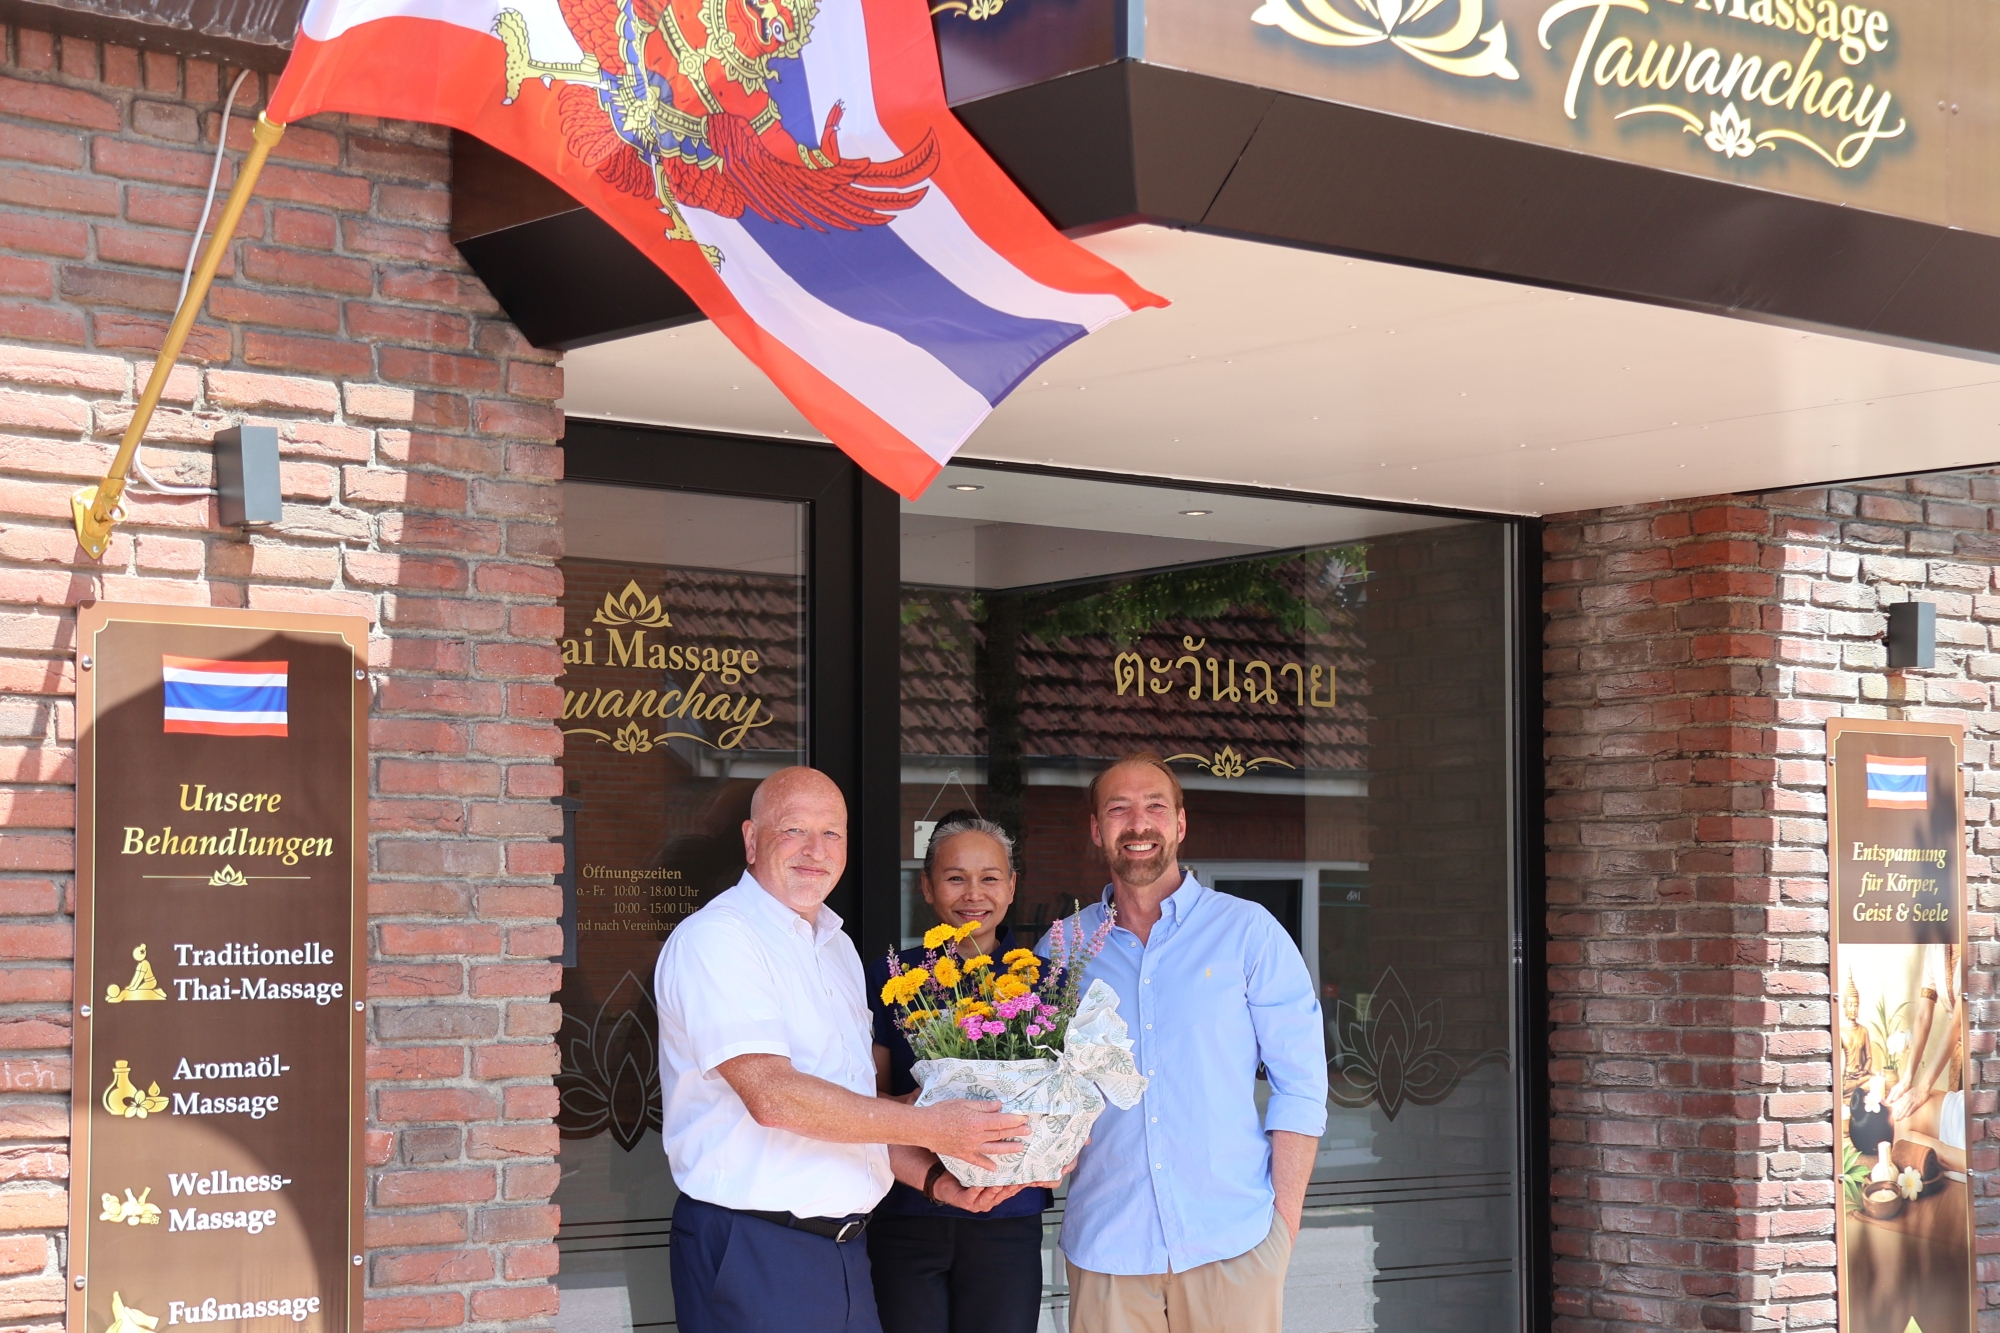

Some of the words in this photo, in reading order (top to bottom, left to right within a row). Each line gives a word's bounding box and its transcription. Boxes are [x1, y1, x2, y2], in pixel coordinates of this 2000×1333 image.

[1695, 0, 1889, 65] assage
[1538, 0, 1906, 168] Tawanchay
[562, 627, 595, 665] ai
[605, 628, 760, 684] Massage
[1114, 635, 1336, 708] ตะวันฉาย
[561, 668, 774, 750] wanchay
[179, 784, 282, 813] Unsere
[121, 827, 334, 866] Behandlungen
[1852, 841, 1947, 869] Entspannung
[582, 863, 682, 882] Öffnungszeiten
[1859, 871, 1884, 898] für
[1886, 872, 1939, 898] Körper,
[593, 885, 606, 897] Fr.
[613, 885, 640, 897] 10:00
[650, 885, 676, 897] 18:00
[679, 885, 700, 897] Uhr
[613, 902, 640, 914] 10:00
[650, 902, 676, 914] 15:00
[679, 902, 700, 914] Uhr
[1853, 902, 1893, 922] Geist
[1895, 902, 1910, 922] &
[1912, 902, 1949, 922] Seele
[577, 919, 591, 931] nd
[594, 919, 620, 931] nach
[622, 920, 678, 931] Vereinbar
[173, 942, 334, 966] Traditionelle
[173, 977, 344, 1006] Thai-Massage
[173, 1054, 290, 1080] Aromaöl-
[172, 1091, 279, 1119] Massage
[168, 1170, 292, 1197] Wellness-
[168, 1207, 276, 1234] Massage
[168, 1296, 320, 1325] Fußmassage
